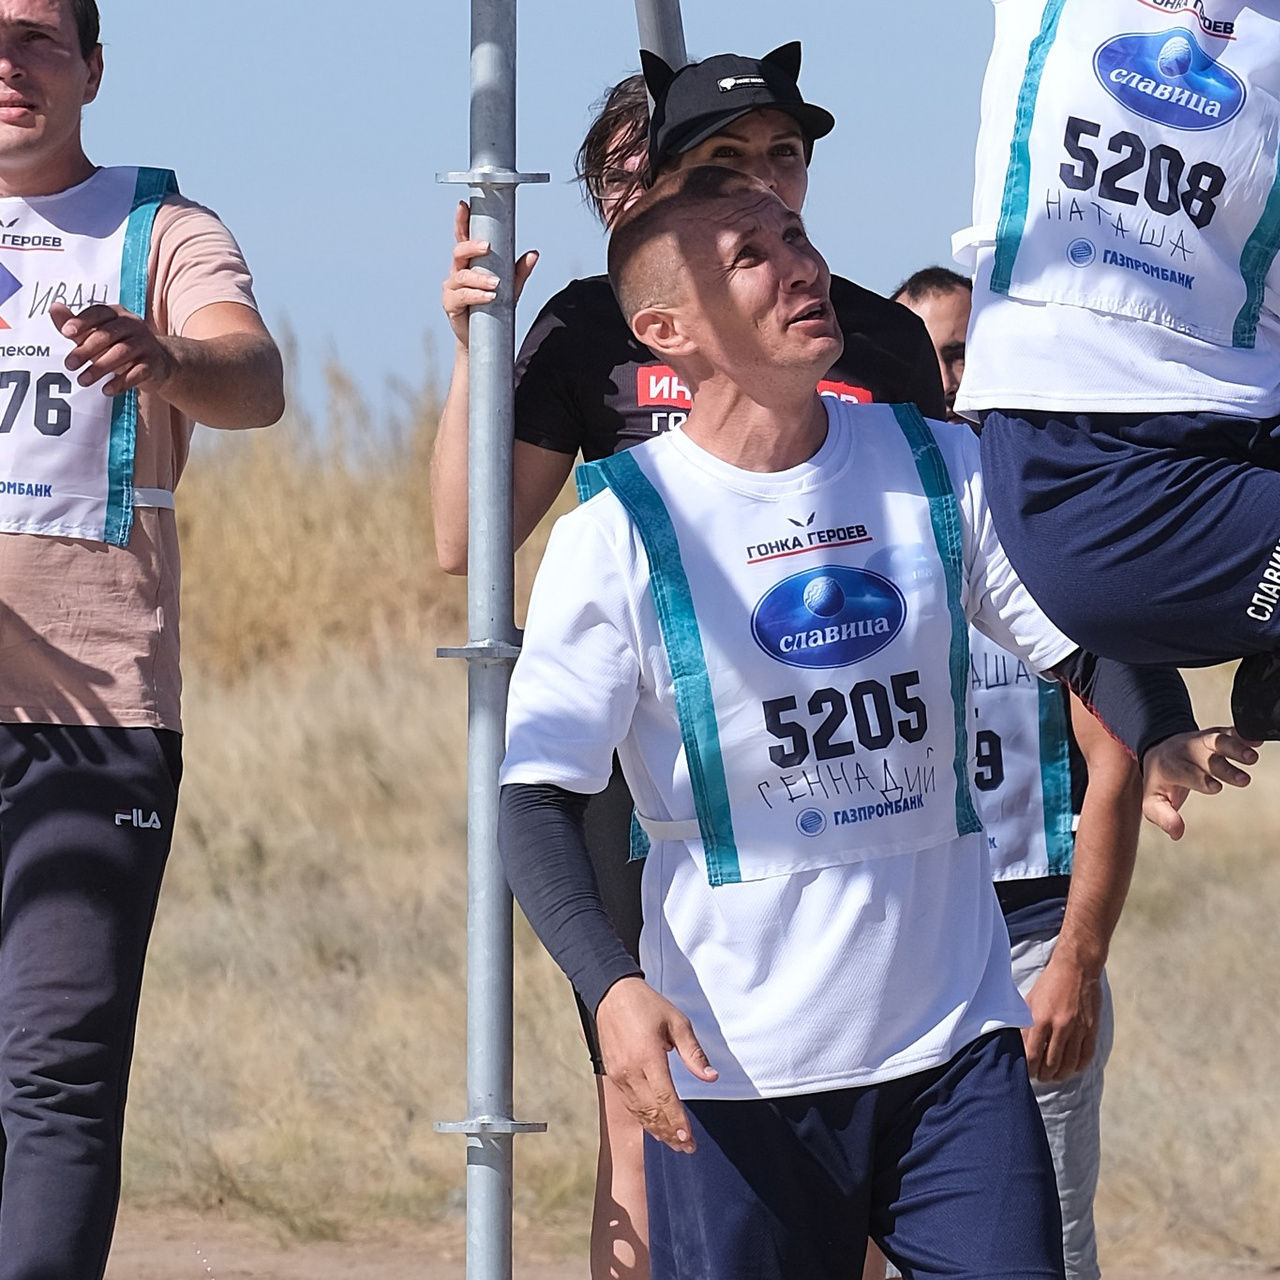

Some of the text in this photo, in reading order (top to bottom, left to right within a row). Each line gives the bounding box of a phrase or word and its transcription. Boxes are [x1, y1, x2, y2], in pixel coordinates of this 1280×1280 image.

[1109, 68, 1221, 118] славица
[1059, 116, 1227, 230] 5208
[2, 234, 62, 248] ГЕРОЕВ
[1046, 188, 1194, 262] НАТАША
[1102, 249, 1195, 290] ГАЗПРОМБАНК
[746, 524, 868, 559] ГОНКА ГЕРОЕВ
[779, 617, 890, 652] славица
[762, 670, 928, 769] 5205
[757, 747, 936, 809] ГЕННАДИЙ
[115, 808, 162, 829] FILA
[833, 794, 924, 826] ГАЗПРОМБАНК
